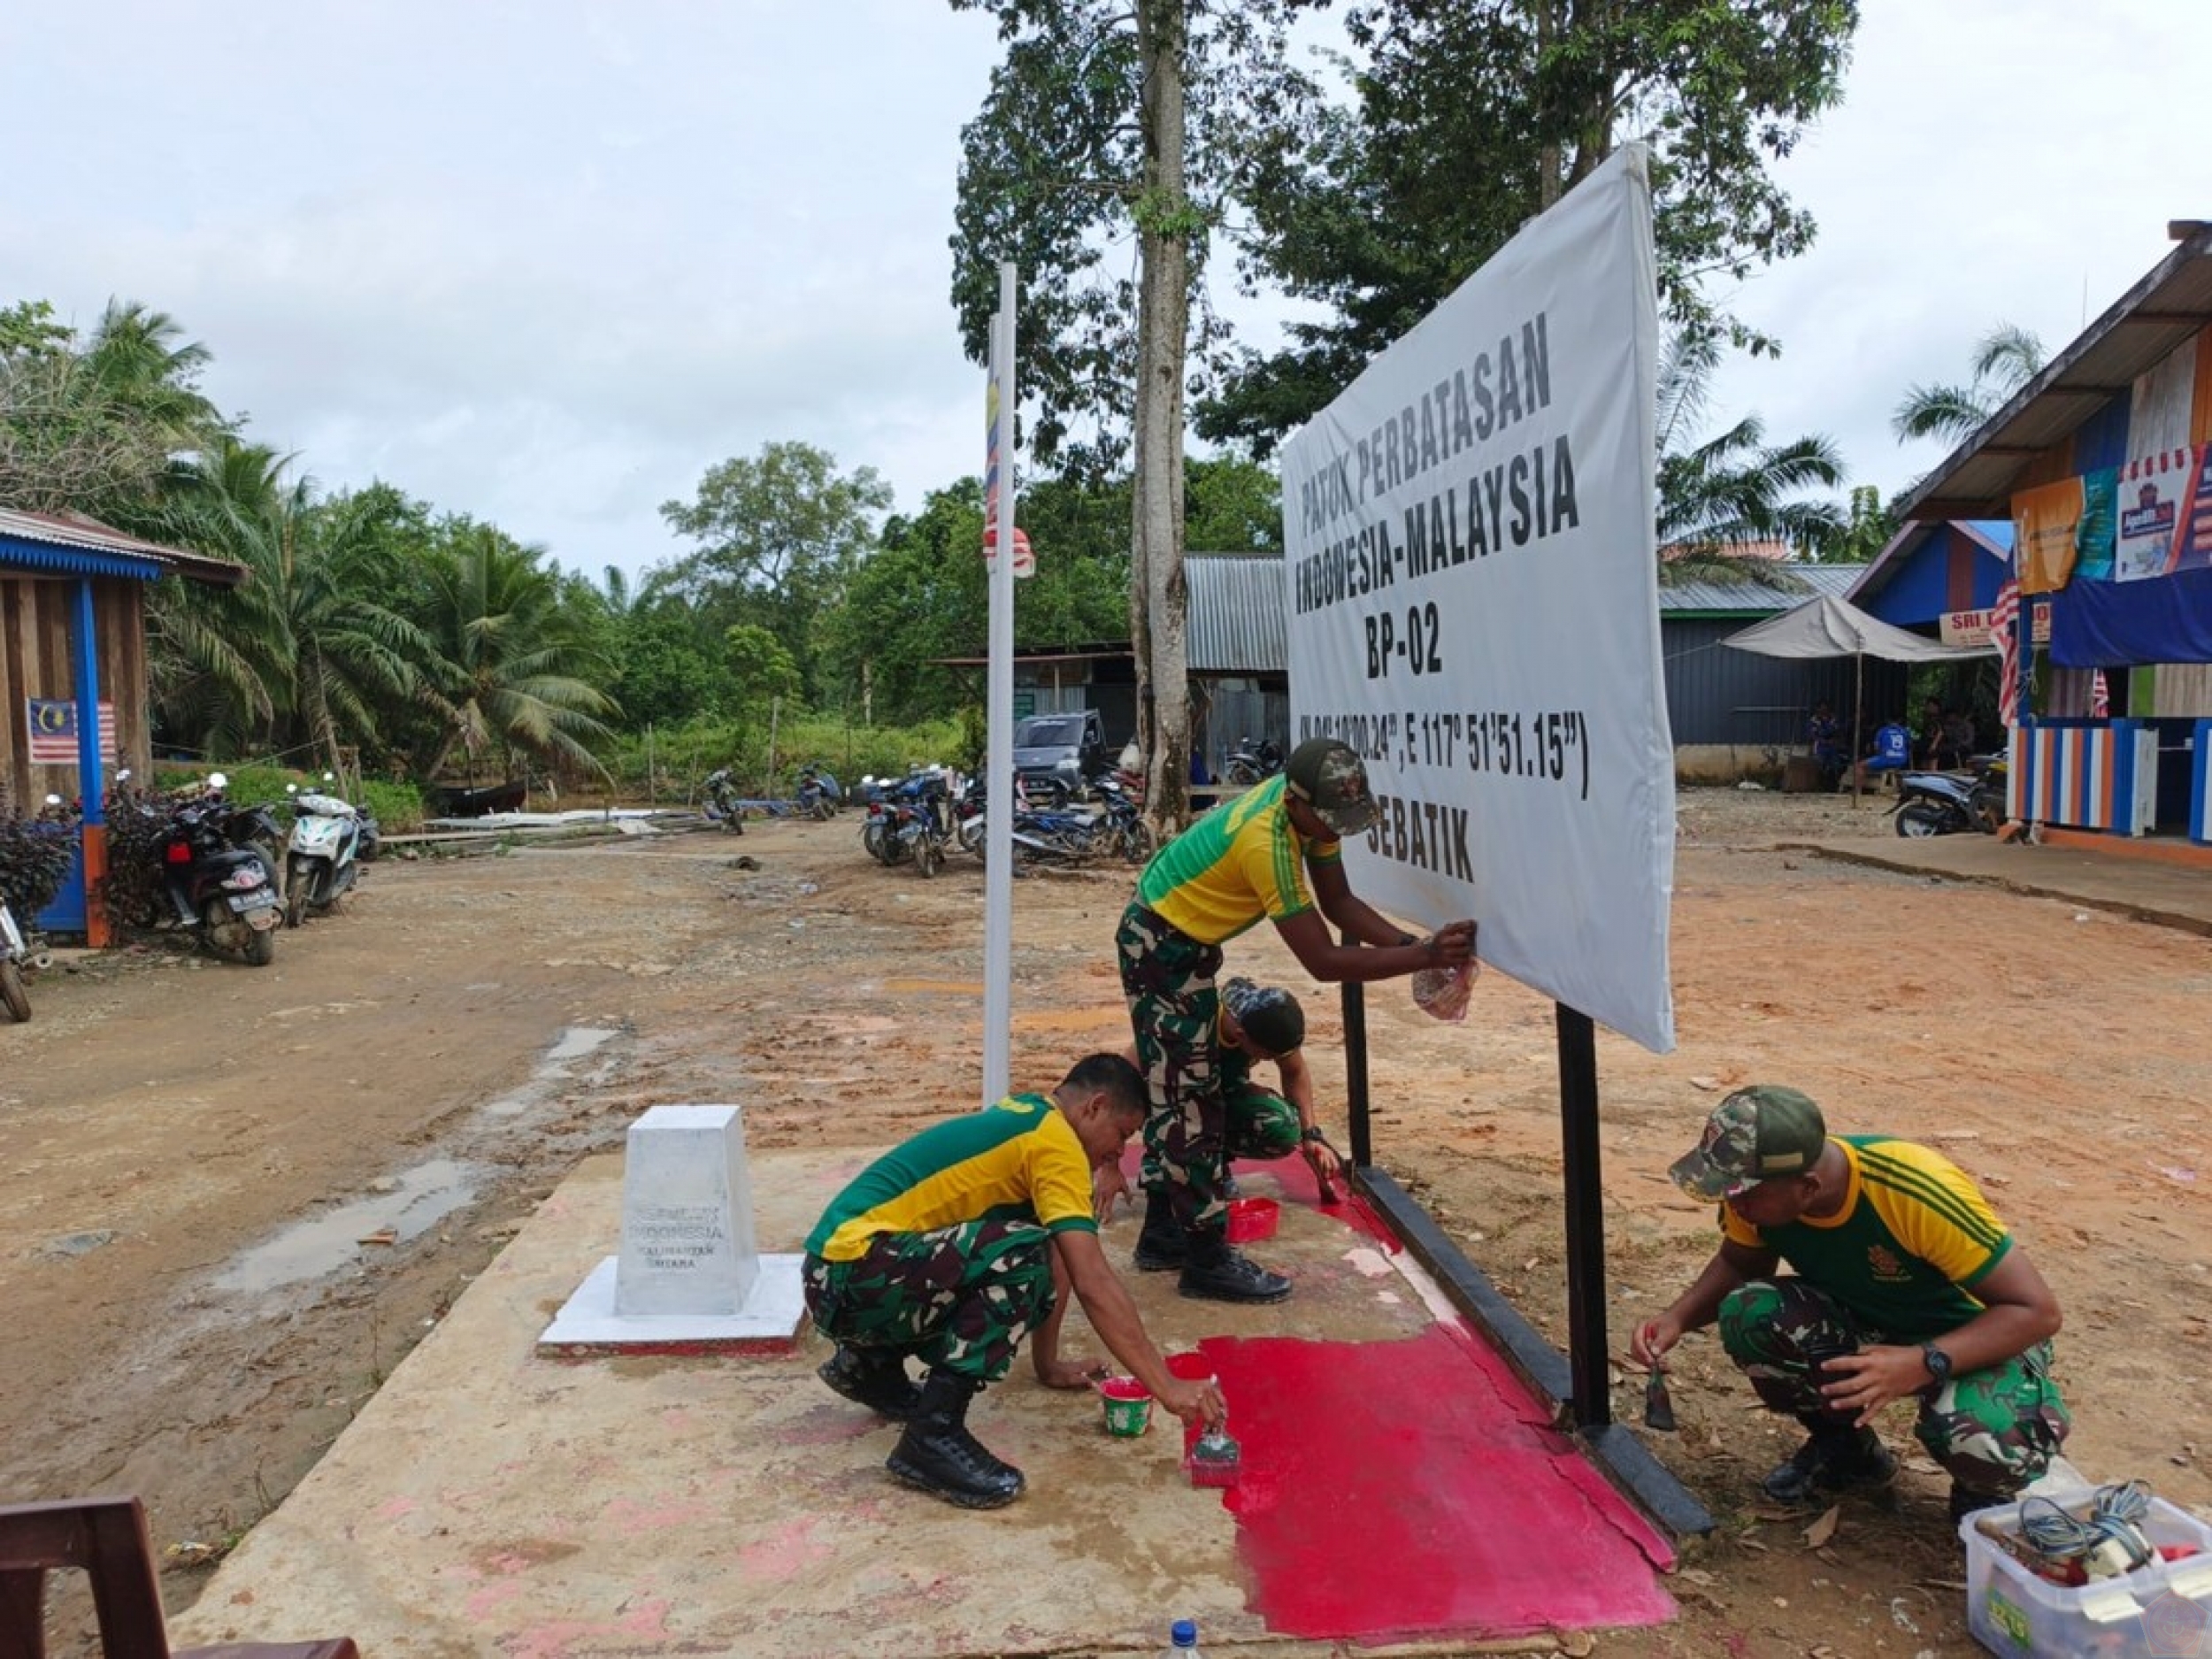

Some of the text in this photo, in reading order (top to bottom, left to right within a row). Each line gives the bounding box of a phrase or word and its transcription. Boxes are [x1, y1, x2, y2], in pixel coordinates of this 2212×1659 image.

[1302, 311, 1551, 538] PATOK PERBATASAN
[1295, 434, 1579, 615] INDONESIA-MALAYSIA
[1364, 602, 1443, 679] BP-02
[1951, 613, 1981, 630] SRI
